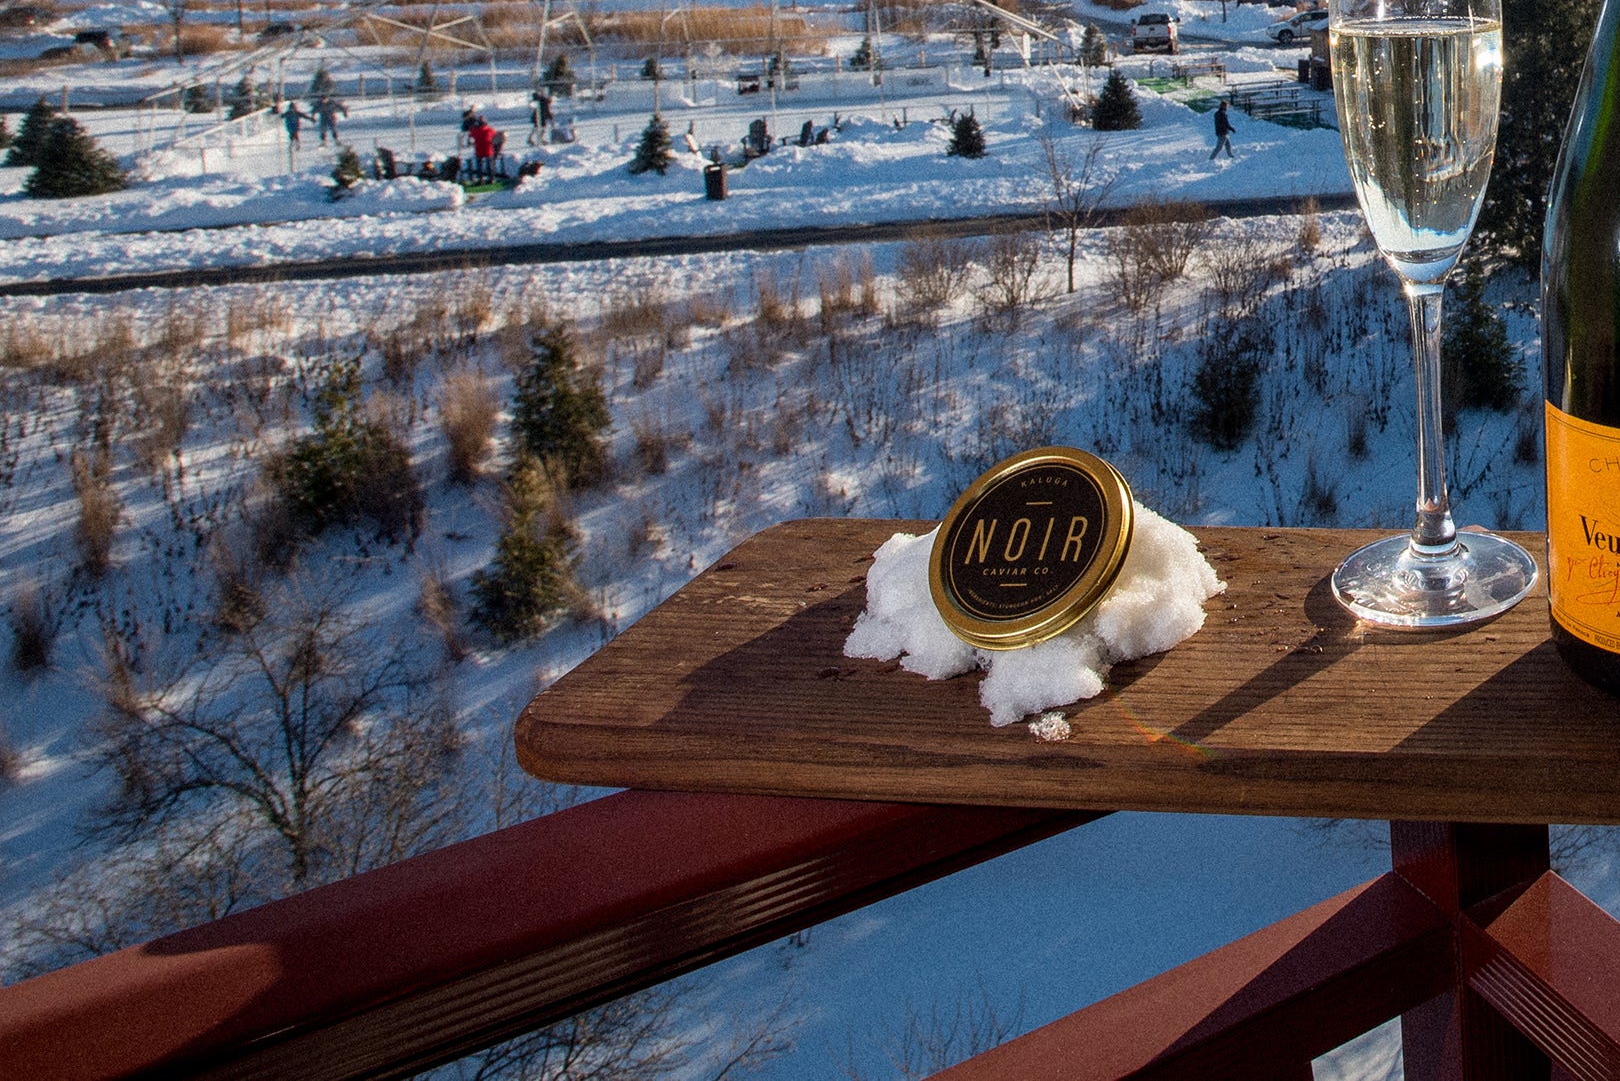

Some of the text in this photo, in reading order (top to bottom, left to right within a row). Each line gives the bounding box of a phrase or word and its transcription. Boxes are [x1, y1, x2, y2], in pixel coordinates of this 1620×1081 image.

[1020, 476, 1069, 488] KALUGA
[964, 515, 1089, 565] NOIR
[982, 567, 1028, 576] CAVIAR
